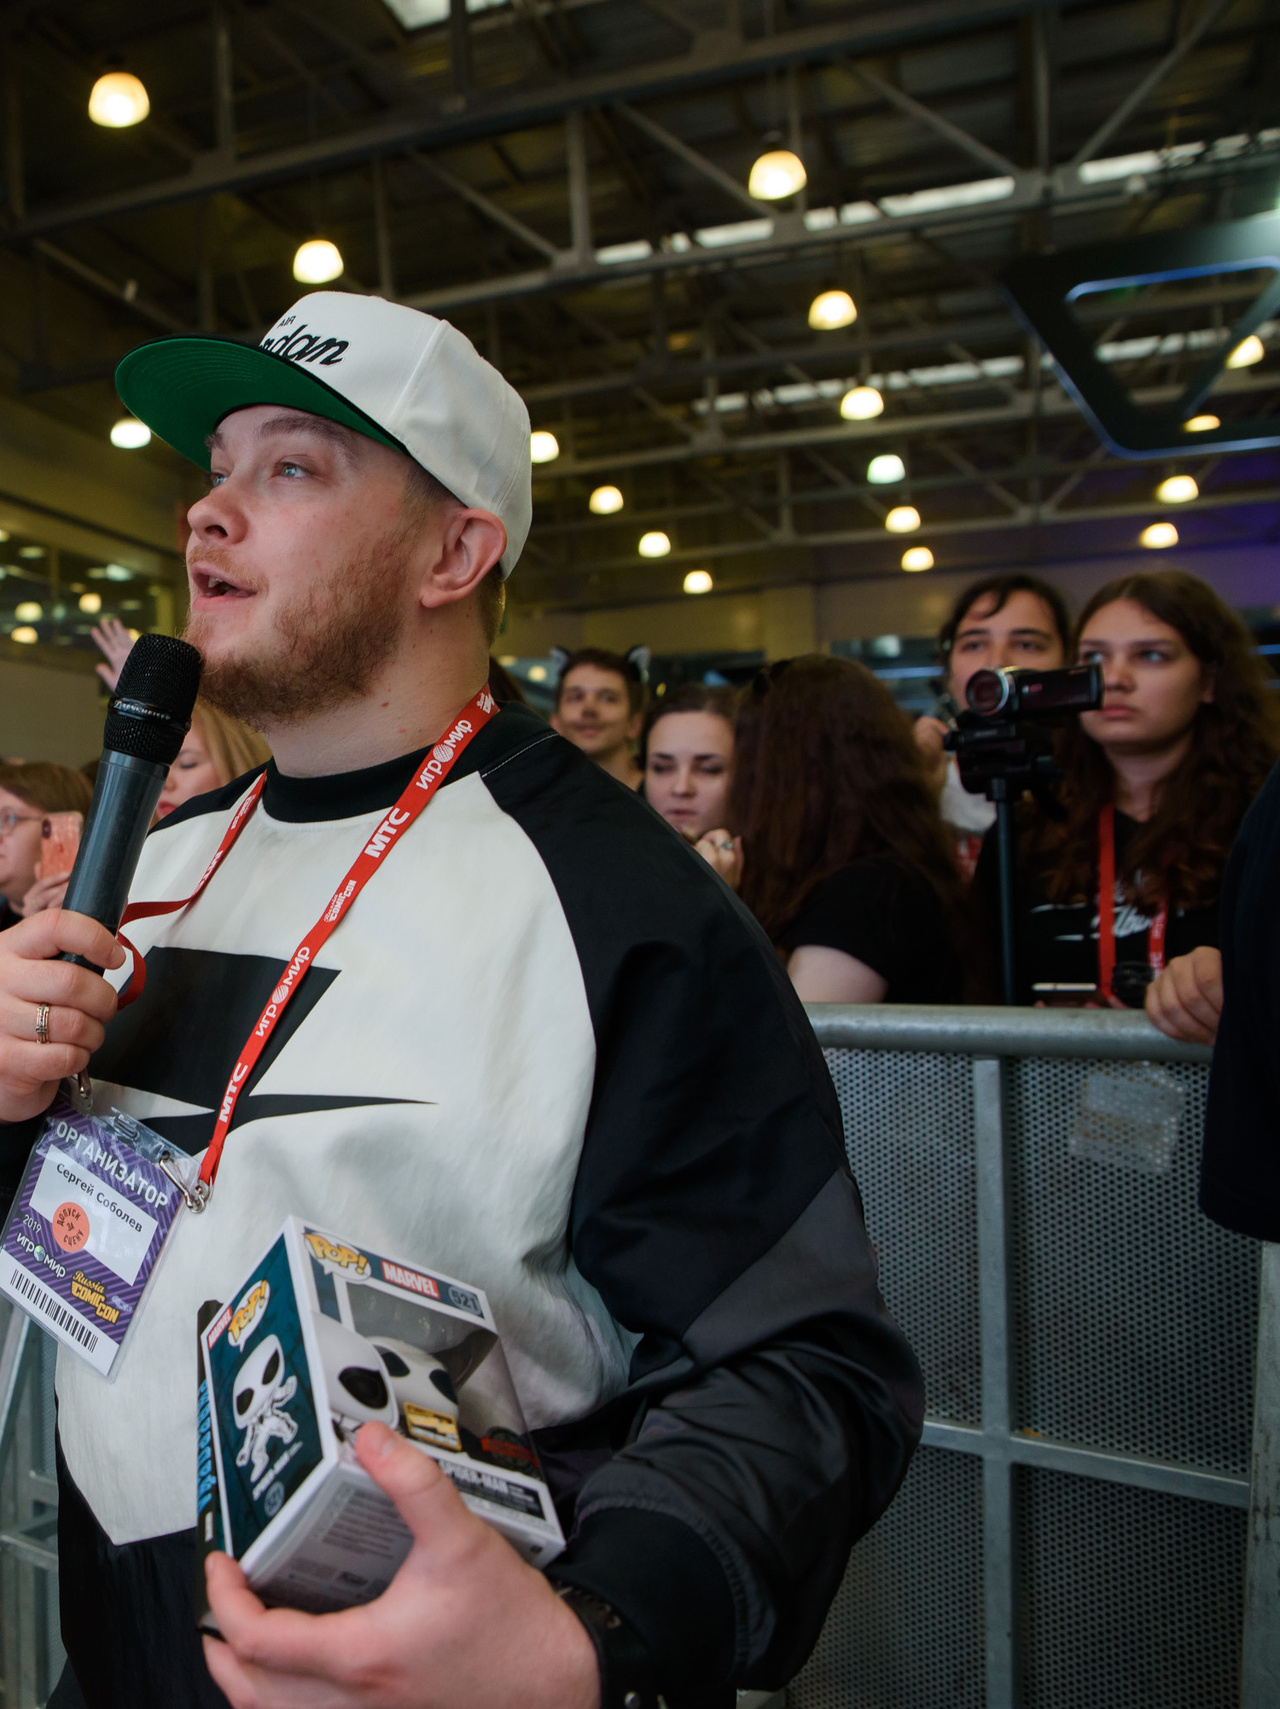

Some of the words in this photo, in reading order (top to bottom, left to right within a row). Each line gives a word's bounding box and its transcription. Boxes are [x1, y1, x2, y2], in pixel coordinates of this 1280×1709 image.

[364, 807, 410, 858] МТС
[219, 1062, 248, 1123] МТС
[56, 1121, 169, 1208] ОРГАНИЗАТОР
[57, 1163, 95, 1197] Сергей
[96, 1191, 143, 1233] Соболев
[22, 1214, 42, 1234] 2019
[304, 1233, 368, 1275] POP!
[72, 1270, 105, 1293] Russia
[382, 1261, 439, 1298] MARVEL
[71, 1280, 106, 1308] COMIC
[97, 1302, 120, 1324] CON
